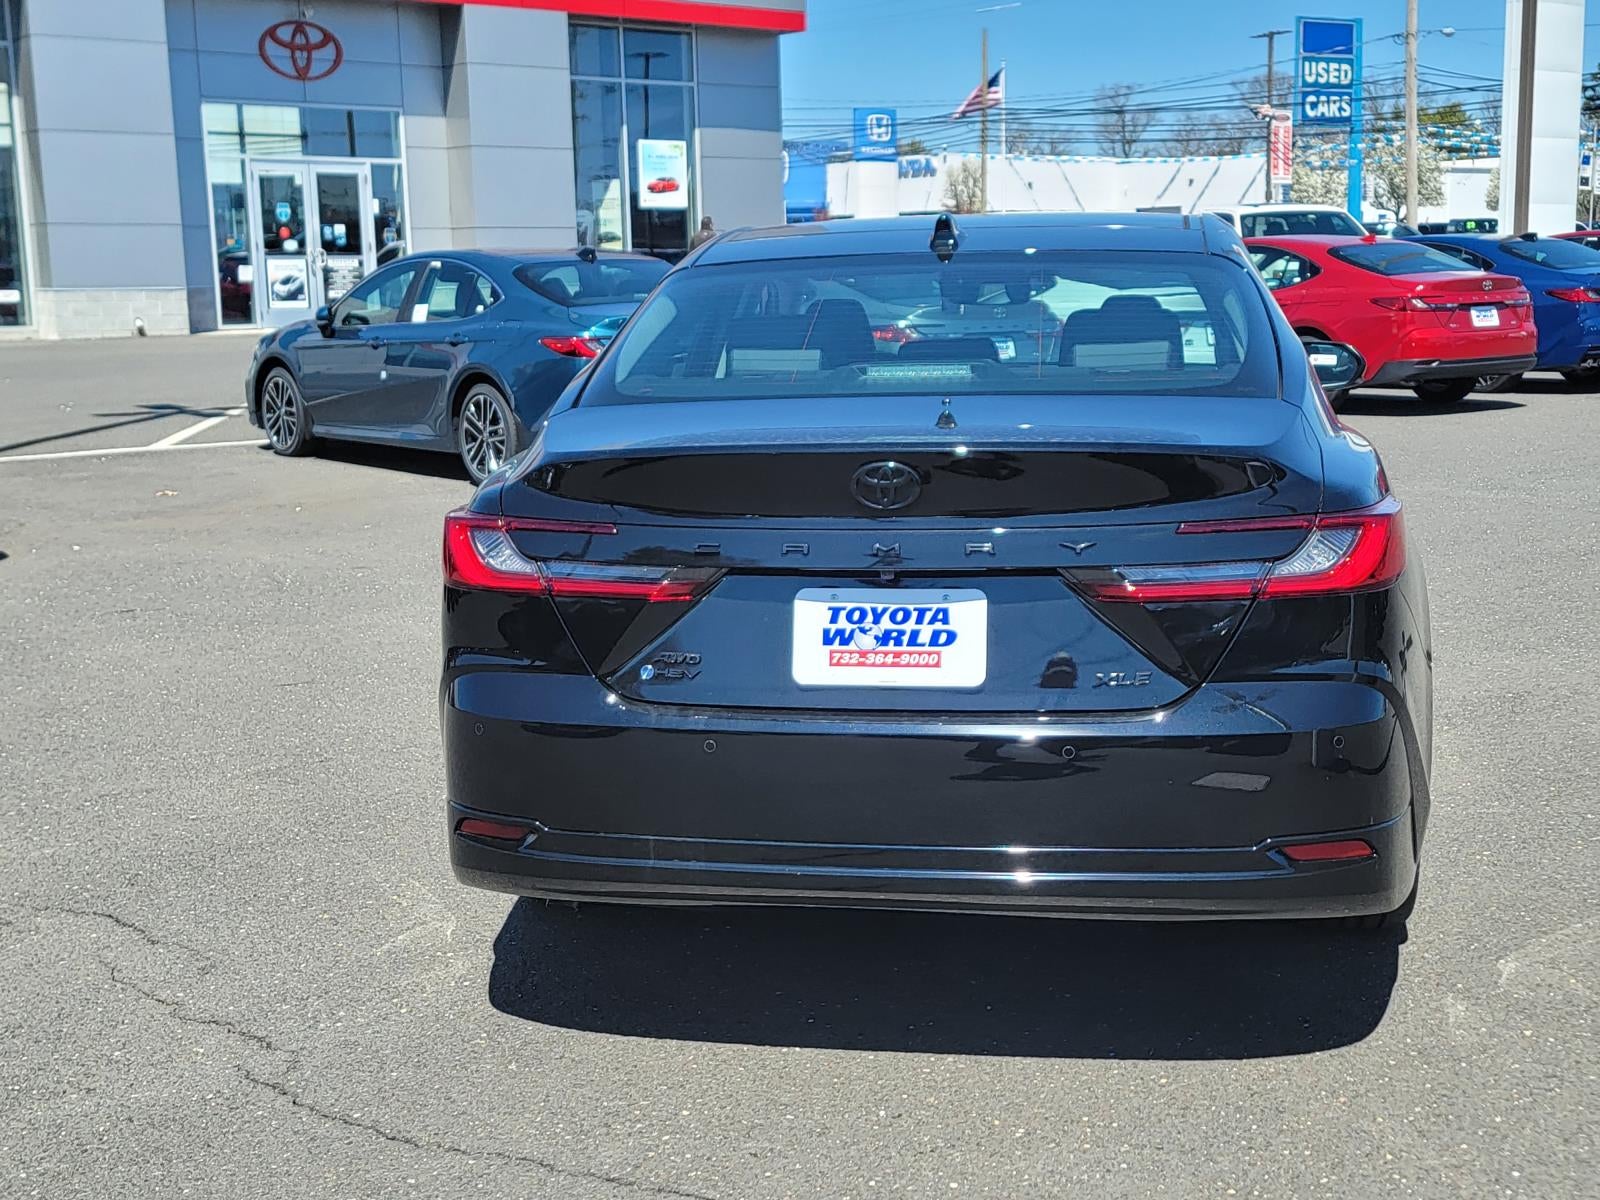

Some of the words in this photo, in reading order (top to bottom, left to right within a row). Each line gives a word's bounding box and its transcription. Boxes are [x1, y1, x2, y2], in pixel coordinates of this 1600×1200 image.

[1304, 61, 1352, 85] USED
[1305, 94, 1351, 117] CARS
[694, 541, 1097, 556] CAMRY
[827, 606, 951, 626] TOYOTA
[822, 625, 958, 650] WORLD
[651, 651, 703, 664] AWD
[831, 652, 939, 665] 732-364-9000
[654, 667, 703, 680] HEV
[1092, 671, 1153, 689] XLE
